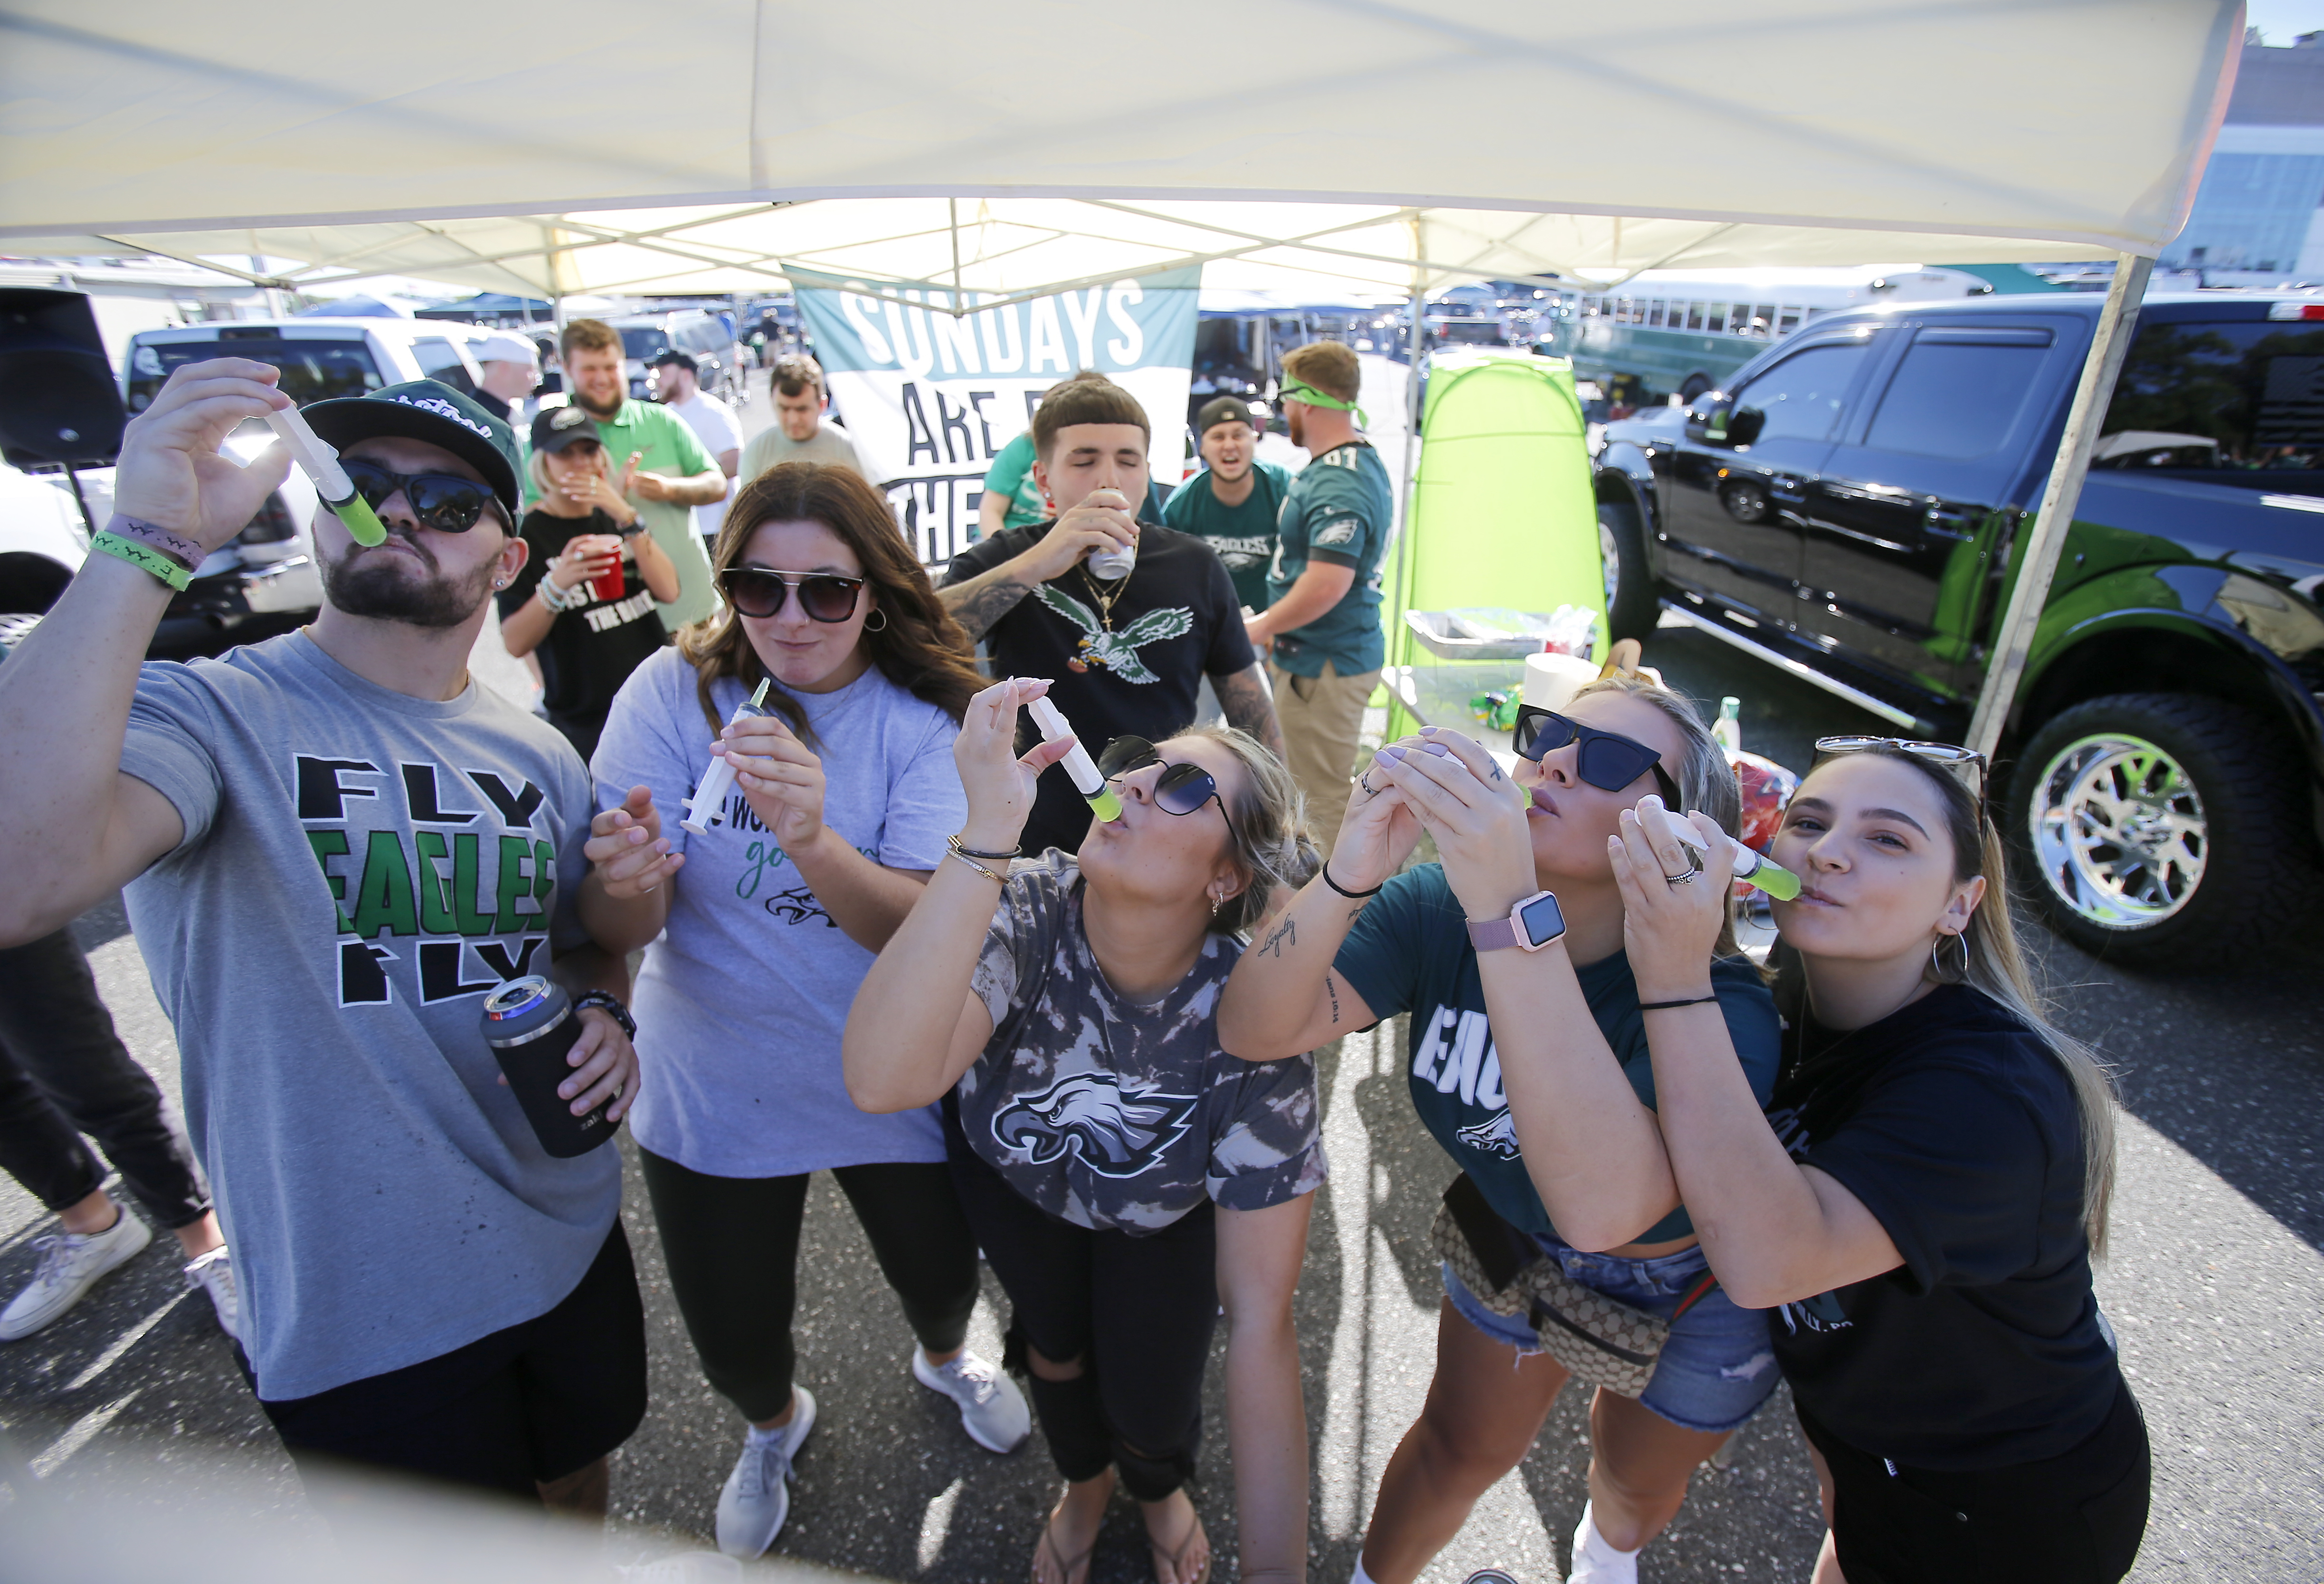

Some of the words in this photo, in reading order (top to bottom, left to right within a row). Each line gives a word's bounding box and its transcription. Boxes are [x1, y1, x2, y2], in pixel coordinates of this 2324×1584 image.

[839, 278, 1144, 377] SUNDAYS
[902, 383, 1002, 465] ARE
[886, 478, 986, 565] THE
[293, 752, 546, 831] FLY
[732, 795, 769, 833] WO
[305, 830, 555, 939] EAGLES
[337, 935, 549, 1008] FLY
[1258, 913, 1296, 957] Loyalty
[1326, 975, 1336, 998] ians
